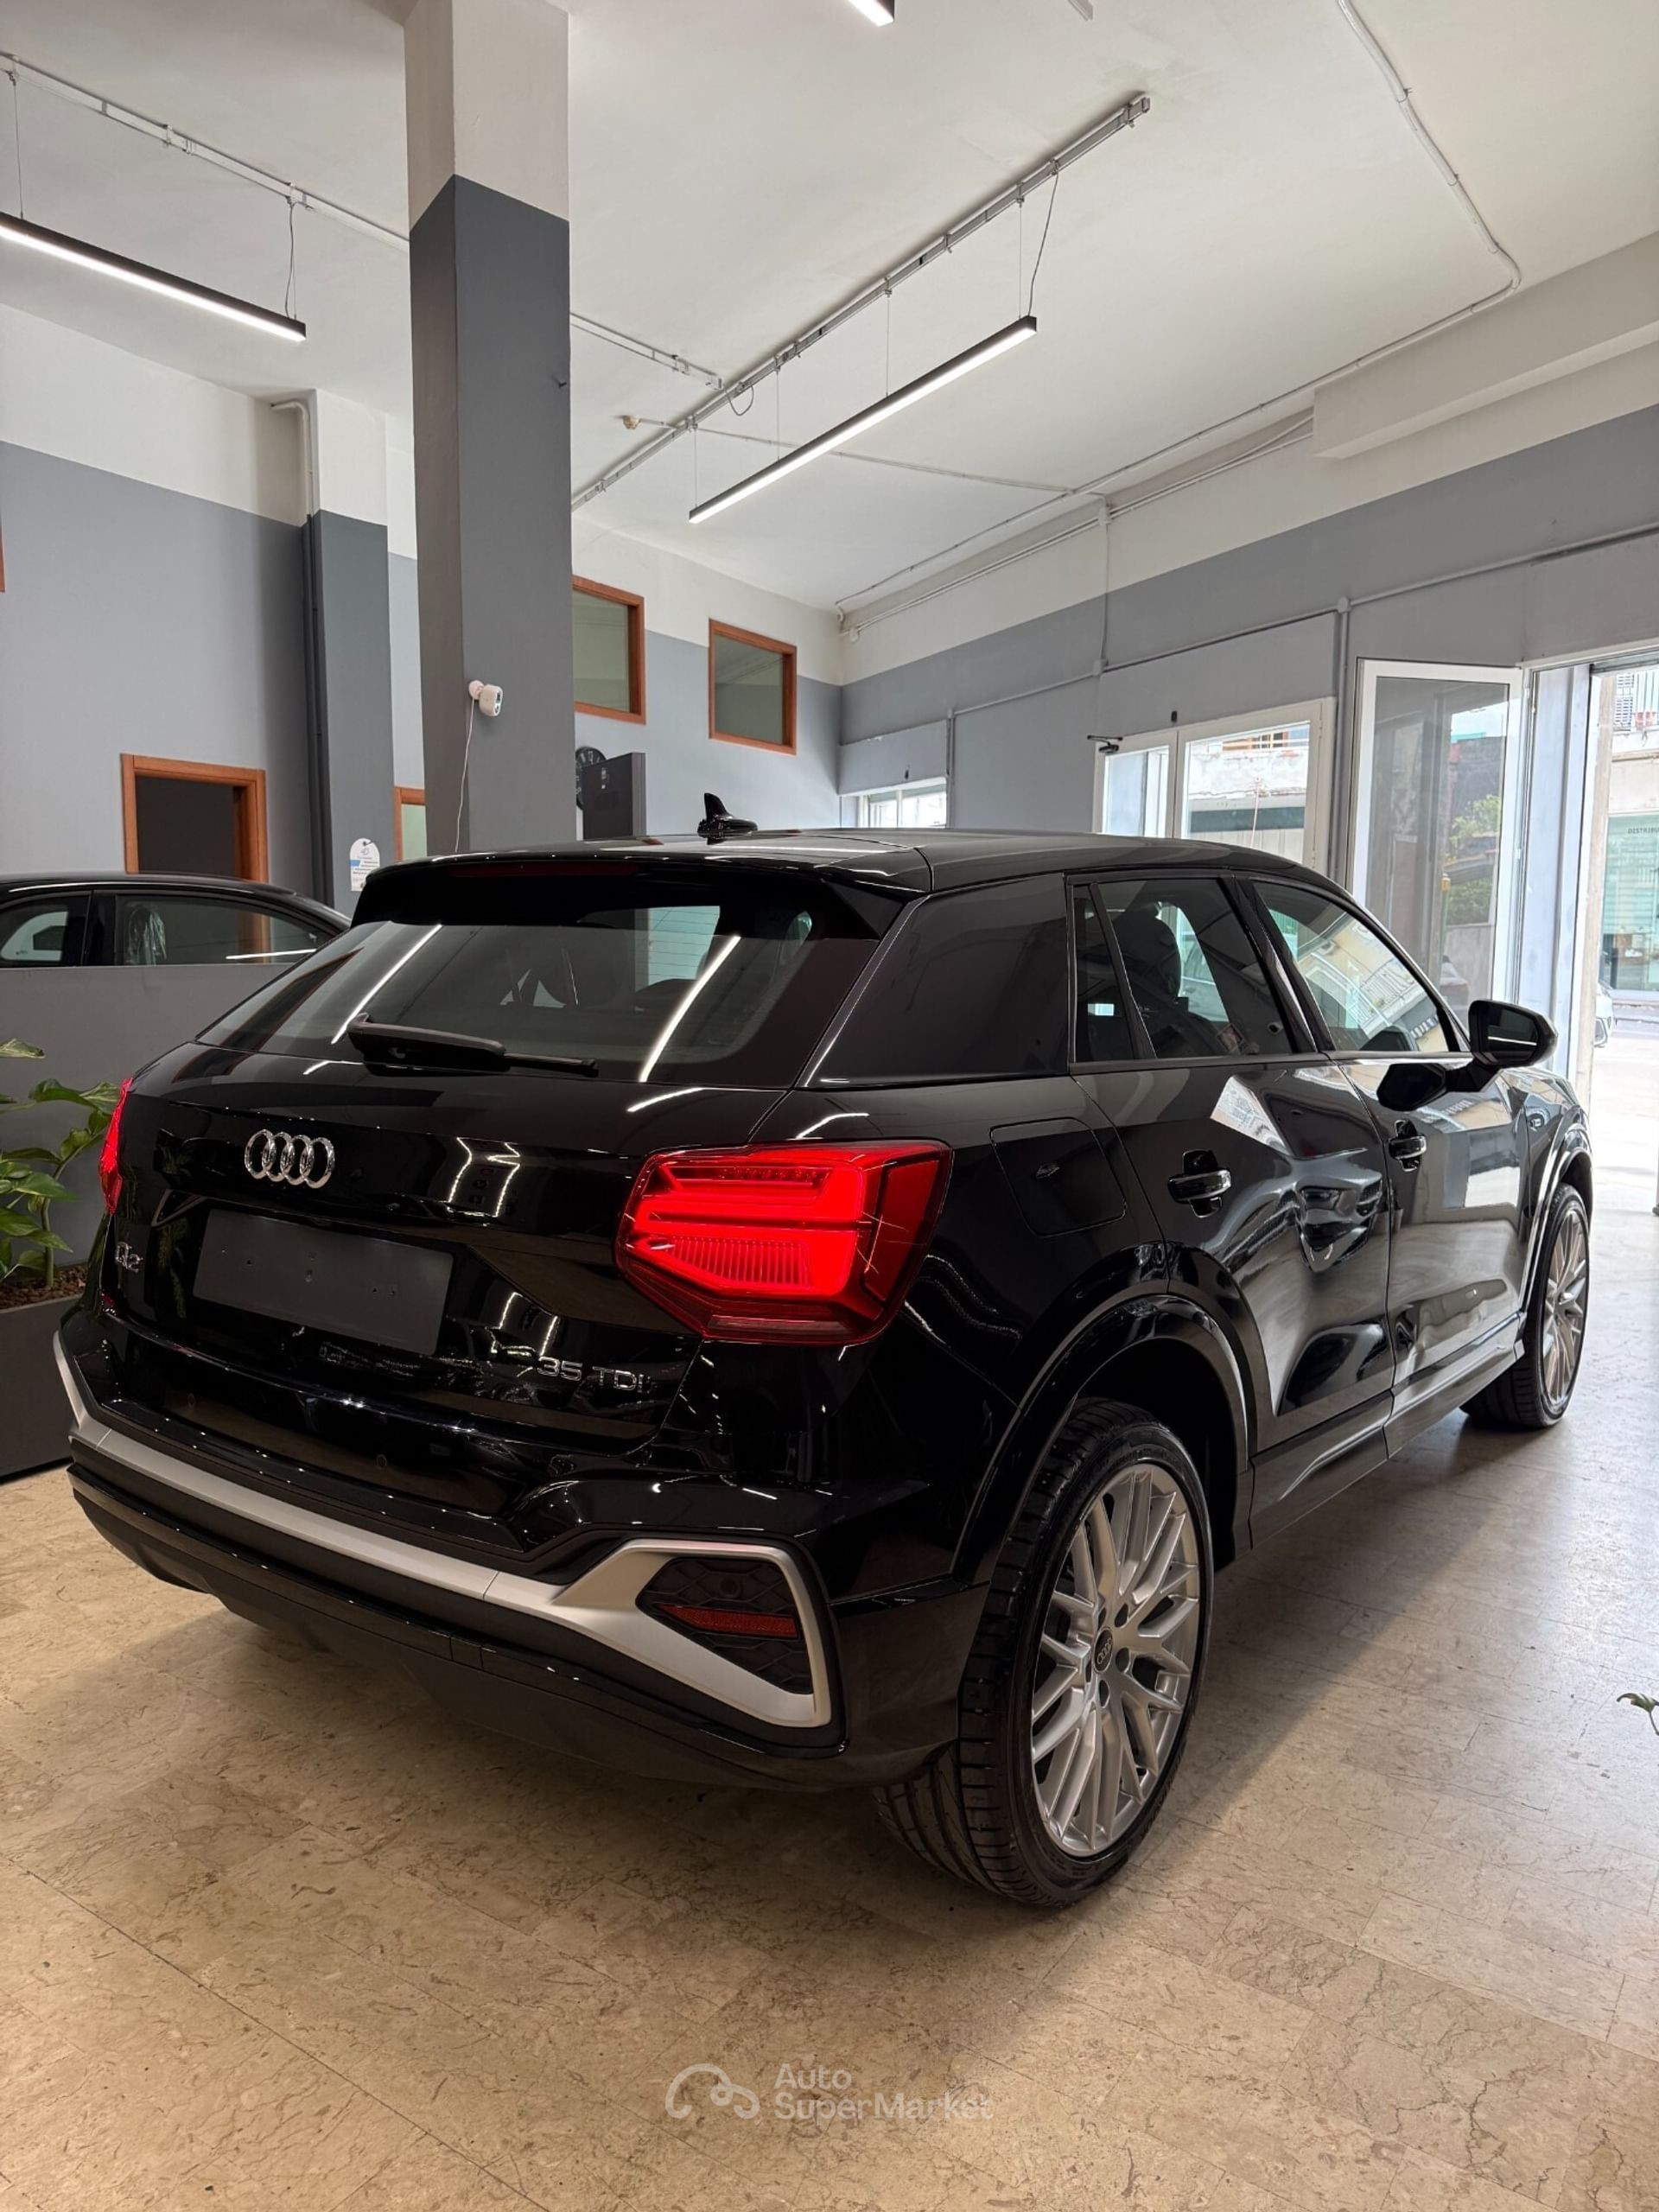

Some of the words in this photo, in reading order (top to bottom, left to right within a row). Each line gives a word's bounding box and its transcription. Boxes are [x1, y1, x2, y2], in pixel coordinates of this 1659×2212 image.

[115, 1242, 143, 1273] Q2
[537, 1356, 583, 1382] 35
[592, 1365, 645, 1394] TDI
